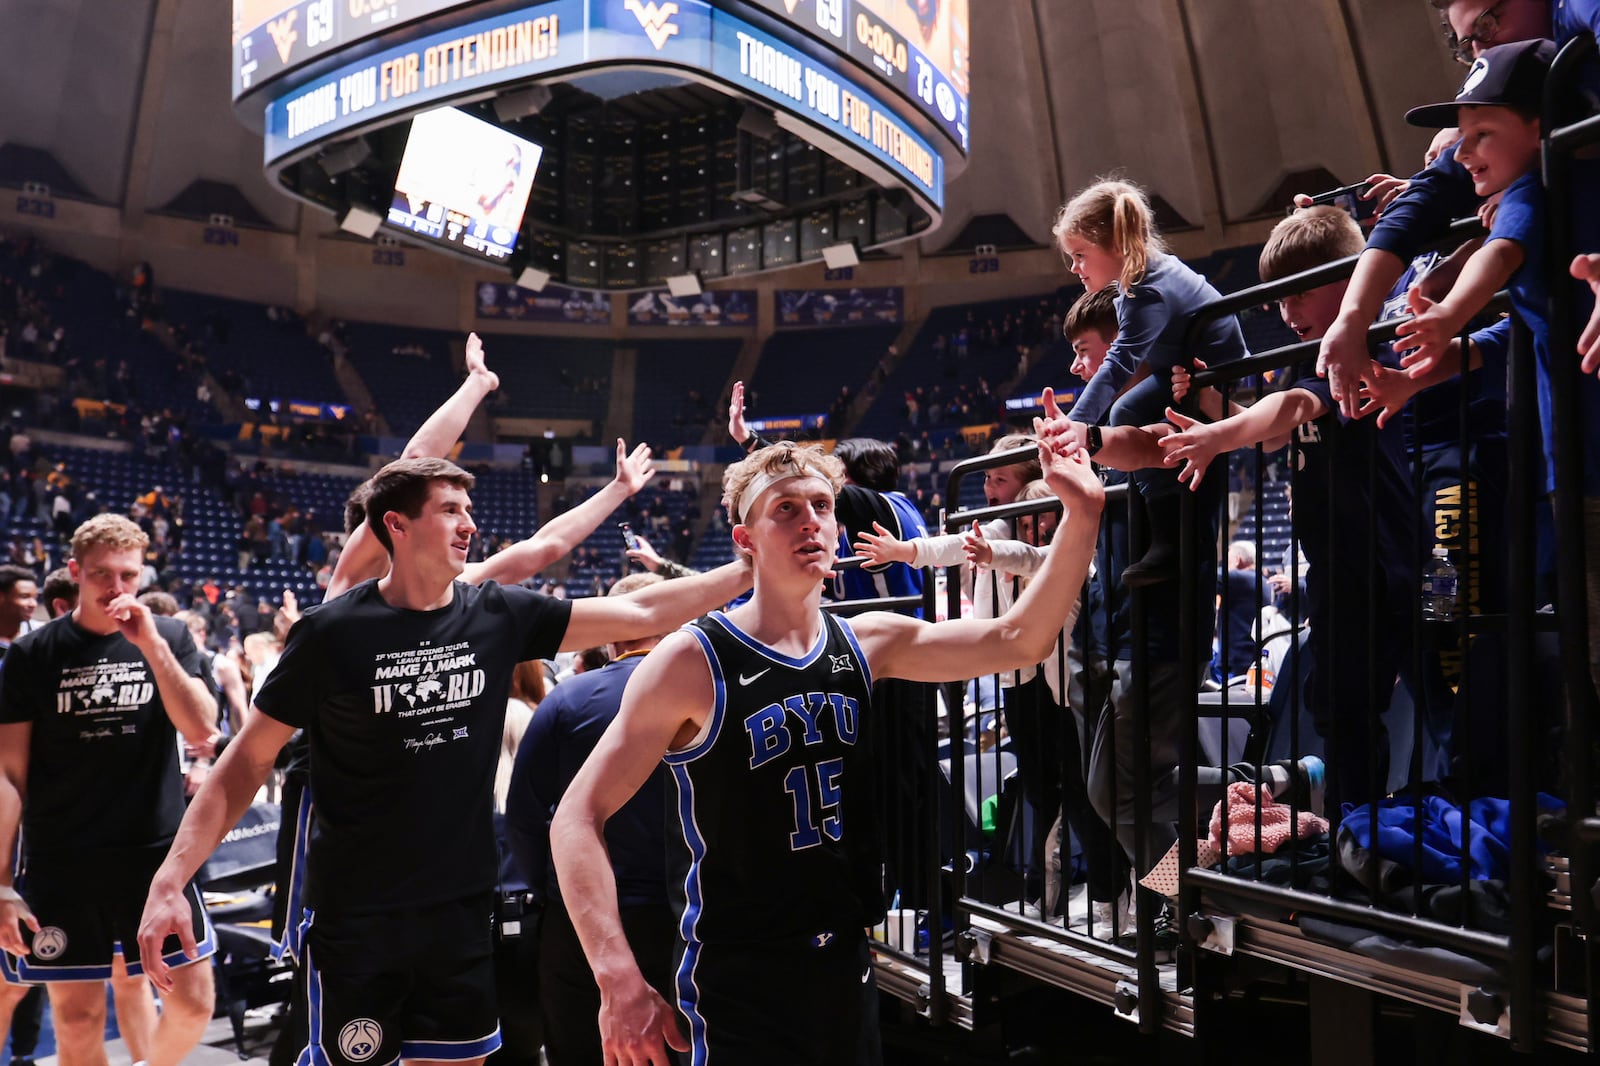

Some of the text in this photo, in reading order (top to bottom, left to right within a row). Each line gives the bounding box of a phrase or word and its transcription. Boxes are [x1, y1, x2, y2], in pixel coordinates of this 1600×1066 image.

[306, 0, 334, 47] 69
[815, 0, 843, 38] 69
[856, 13, 908, 73] 0:00.0
[915, 56, 933, 105] 73
[286, 14, 559, 139] THANK YOU FOR ATTENDING!
[736, 31, 802, 101] THANK
[804, 67, 840, 122] YOU
[841, 89, 870, 141] FOR
[871, 110, 934, 189] ATTENDING!
[375, 653, 476, 680] MAKE A MARK
[396, 656, 421, 665] LEAVE
[417, 647, 444, 656] GOING
[97, 674, 108, 685] A
[110, 671, 147, 683] MARK
[398, 709, 416, 718] THAT
[436, 704, 445, 712] BE
[744, 692, 859, 770] BYU
[784, 757, 844, 851] 15
